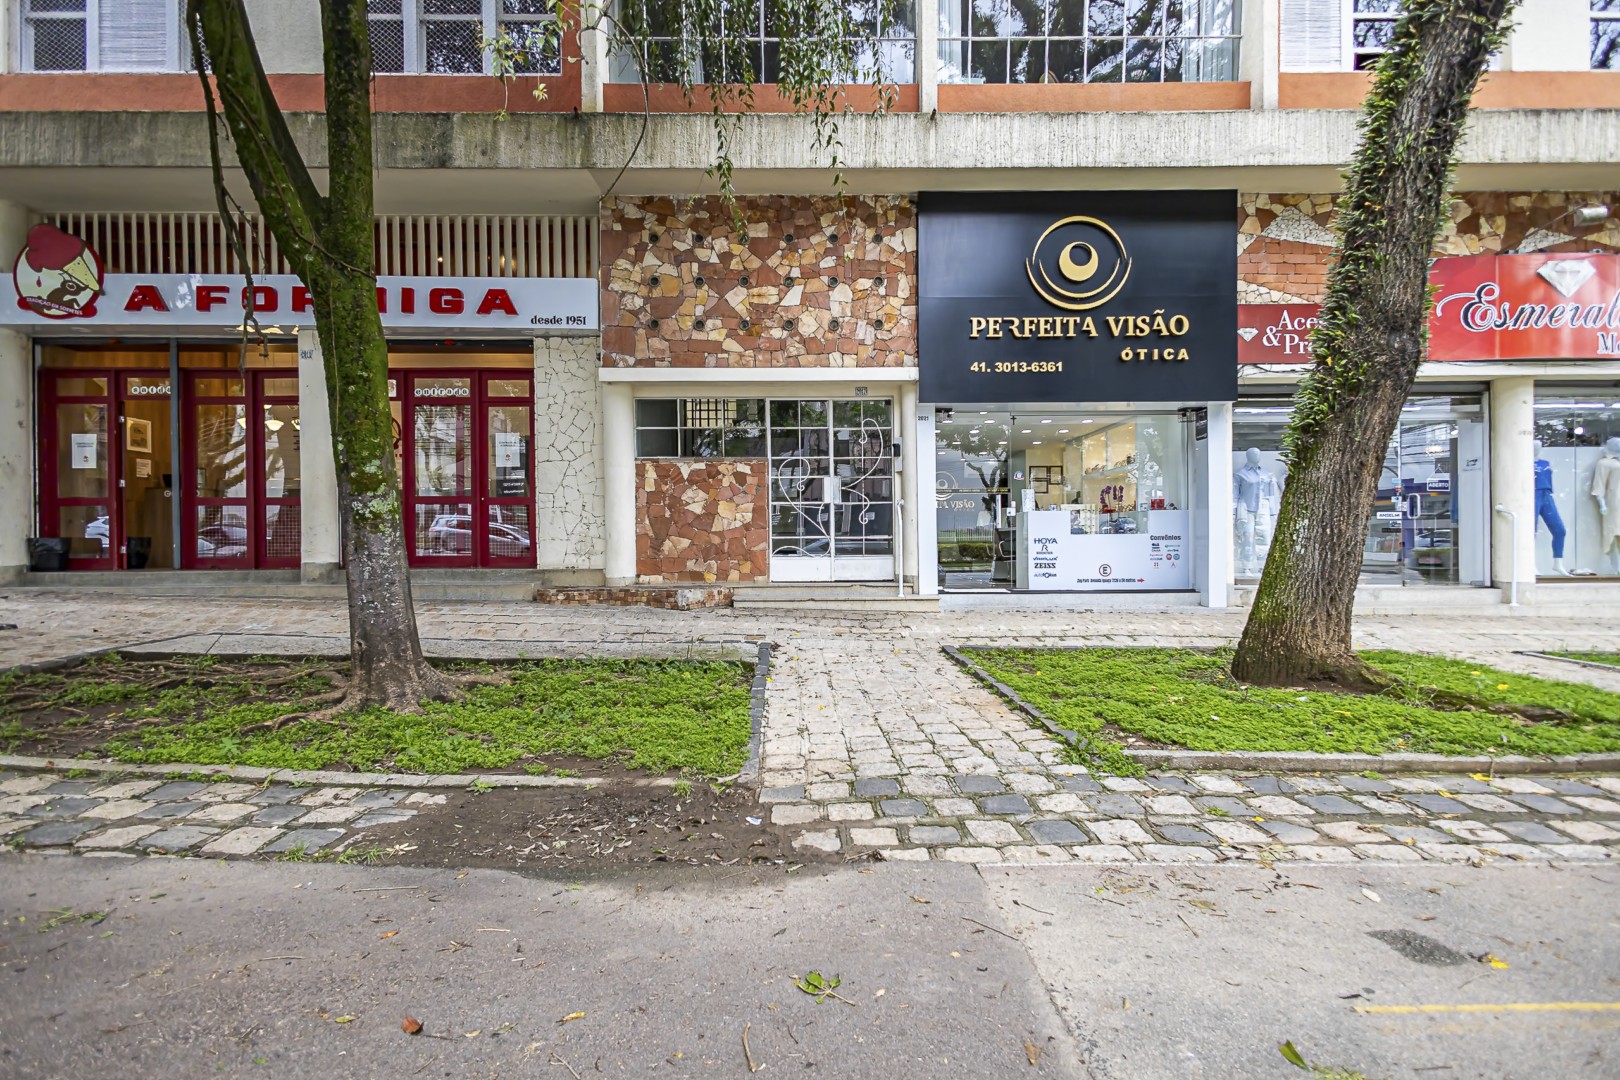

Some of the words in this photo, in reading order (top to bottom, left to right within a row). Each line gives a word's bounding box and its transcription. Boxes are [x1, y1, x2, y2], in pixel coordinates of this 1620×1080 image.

[124, 285, 170, 312] A
[196, 286, 519, 315] FORIGA
[1436, 281, 1620, 332] Esmeral
[530, 314, 563, 326] desde
[565, 315, 587, 326] 1951
[969, 316, 1099, 339] PERFEITA
[1106, 308, 1190, 338] VISÃO
[1262, 325, 1282, 347] &
[1120, 346, 1190, 362] ÓTICA
[970, 361, 991, 373] 41.
[994, 361, 1063, 373] 3013-6361
